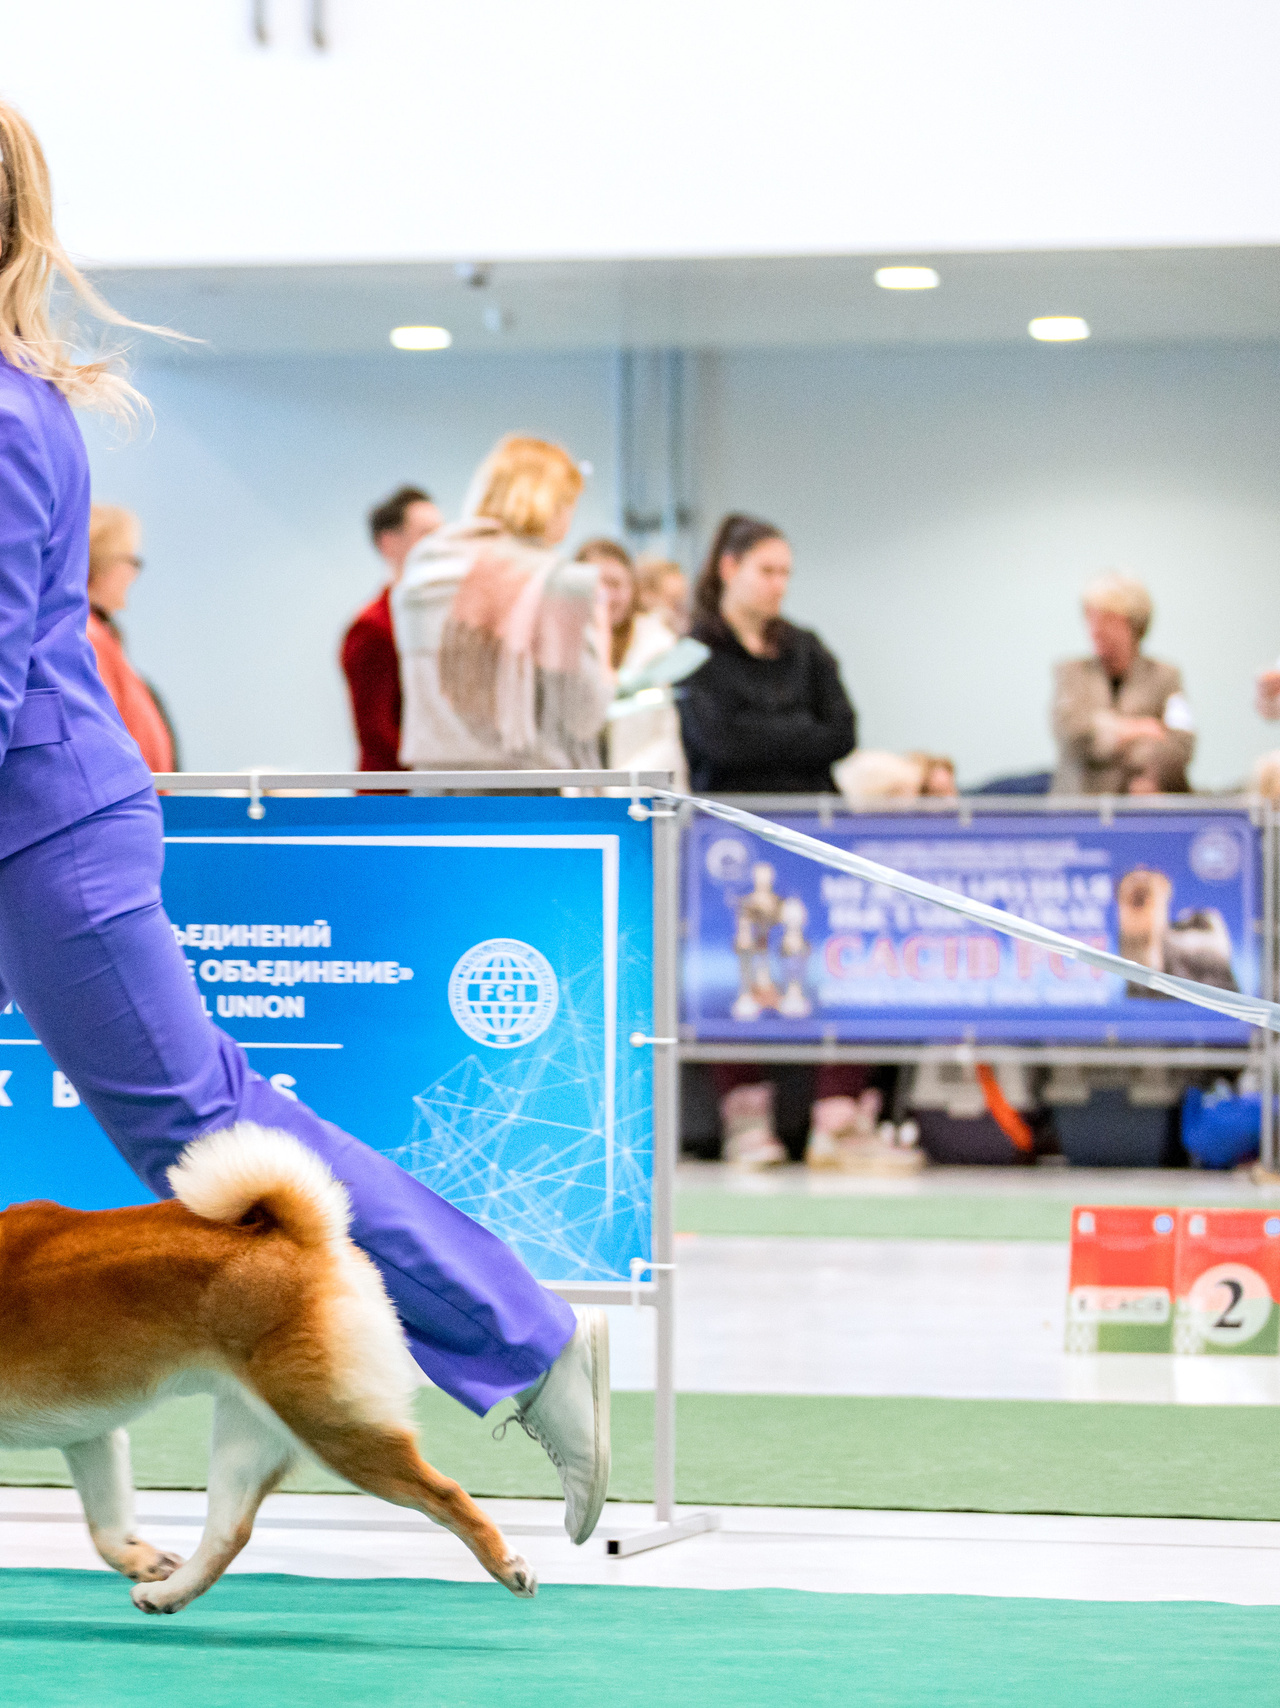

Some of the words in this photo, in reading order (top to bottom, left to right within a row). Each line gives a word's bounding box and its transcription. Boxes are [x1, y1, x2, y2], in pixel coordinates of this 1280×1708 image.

[199, 959, 414, 986] ОБЪЕДИНЕНИЕ»
[479, 983, 526, 1002] FCI
[216, 995, 306, 1019] UNION
[1213, 1277, 1245, 1329] 2
